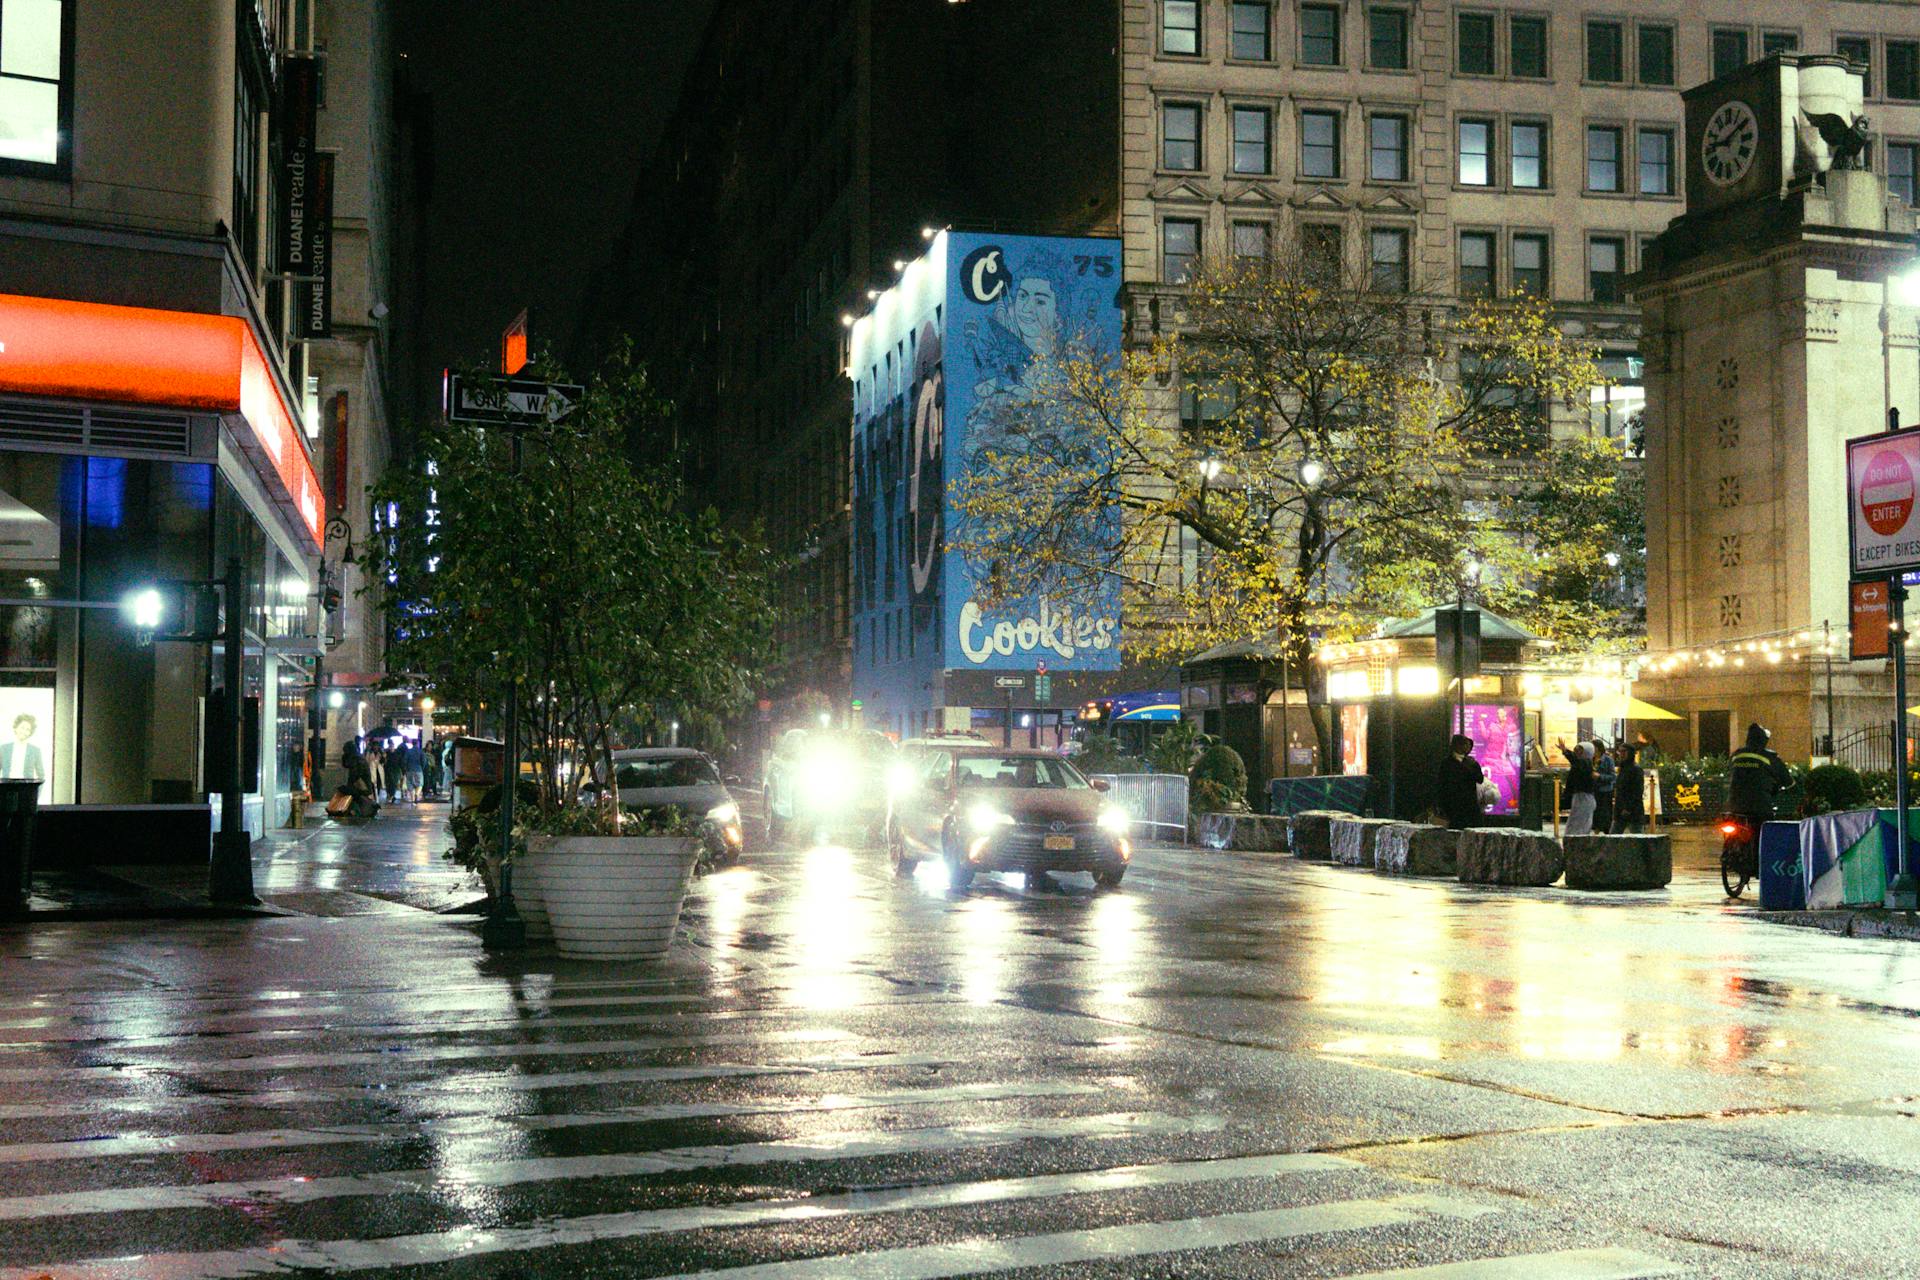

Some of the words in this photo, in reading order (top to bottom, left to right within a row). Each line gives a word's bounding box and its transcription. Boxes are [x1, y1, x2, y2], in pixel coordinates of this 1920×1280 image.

[1073, 255, 1115, 278] 75
[1870, 468, 1881, 481] DO
[1885, 464, 1903, 480] NOT
[1872, 506, 1902, 522] ENTER
[1860, 544, 1891, 562] EXCEPT
[1895, 540, 1920, 557] BIKES
[959, 594, 1116, 664] Cookies
